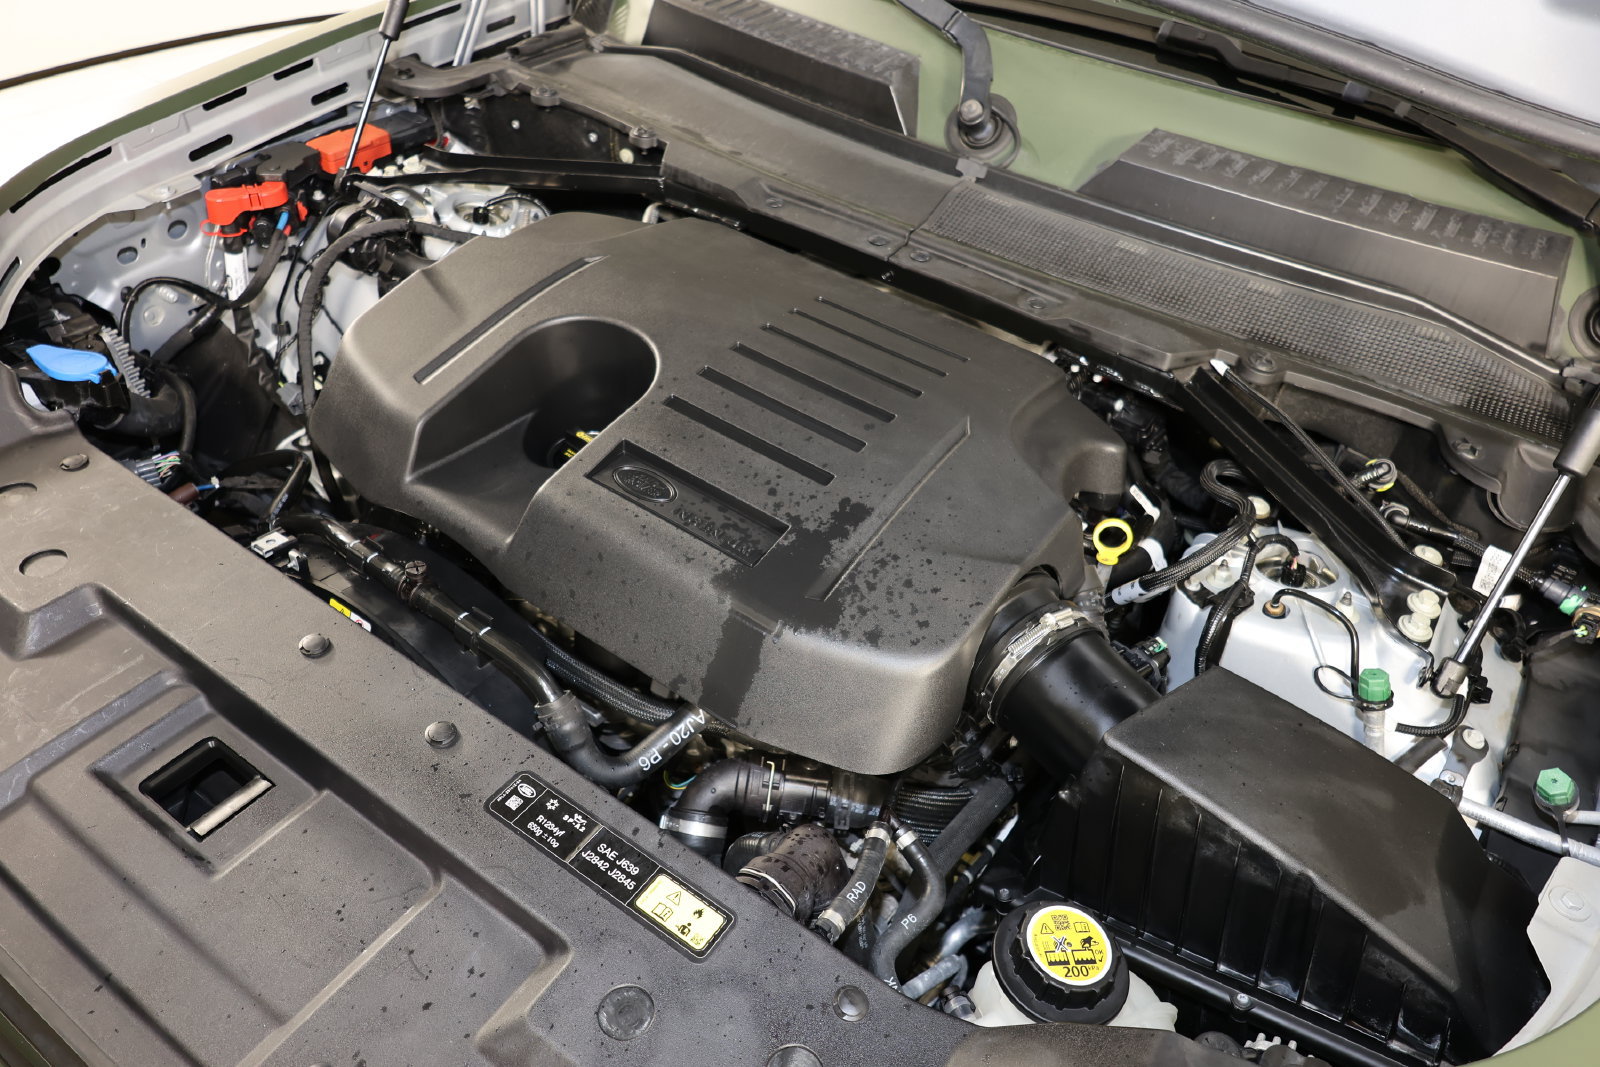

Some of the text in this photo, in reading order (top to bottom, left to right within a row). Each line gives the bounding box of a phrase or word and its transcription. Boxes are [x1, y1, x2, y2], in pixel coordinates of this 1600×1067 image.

[669, 709, 705, 746] AJ20
[638, 748, 662, 771] P6
[527, 821, 543, 837] 650g
[536, 814, 566, 837] R1234yf
[581, 850, 636, 890] J2842 J2845
[597, 843, 640, 876] SAE J639
[846, 881, 866, 903] RAD
[900, 913, 917, 930] P6
[1062, 965, 1090, 978] 200
